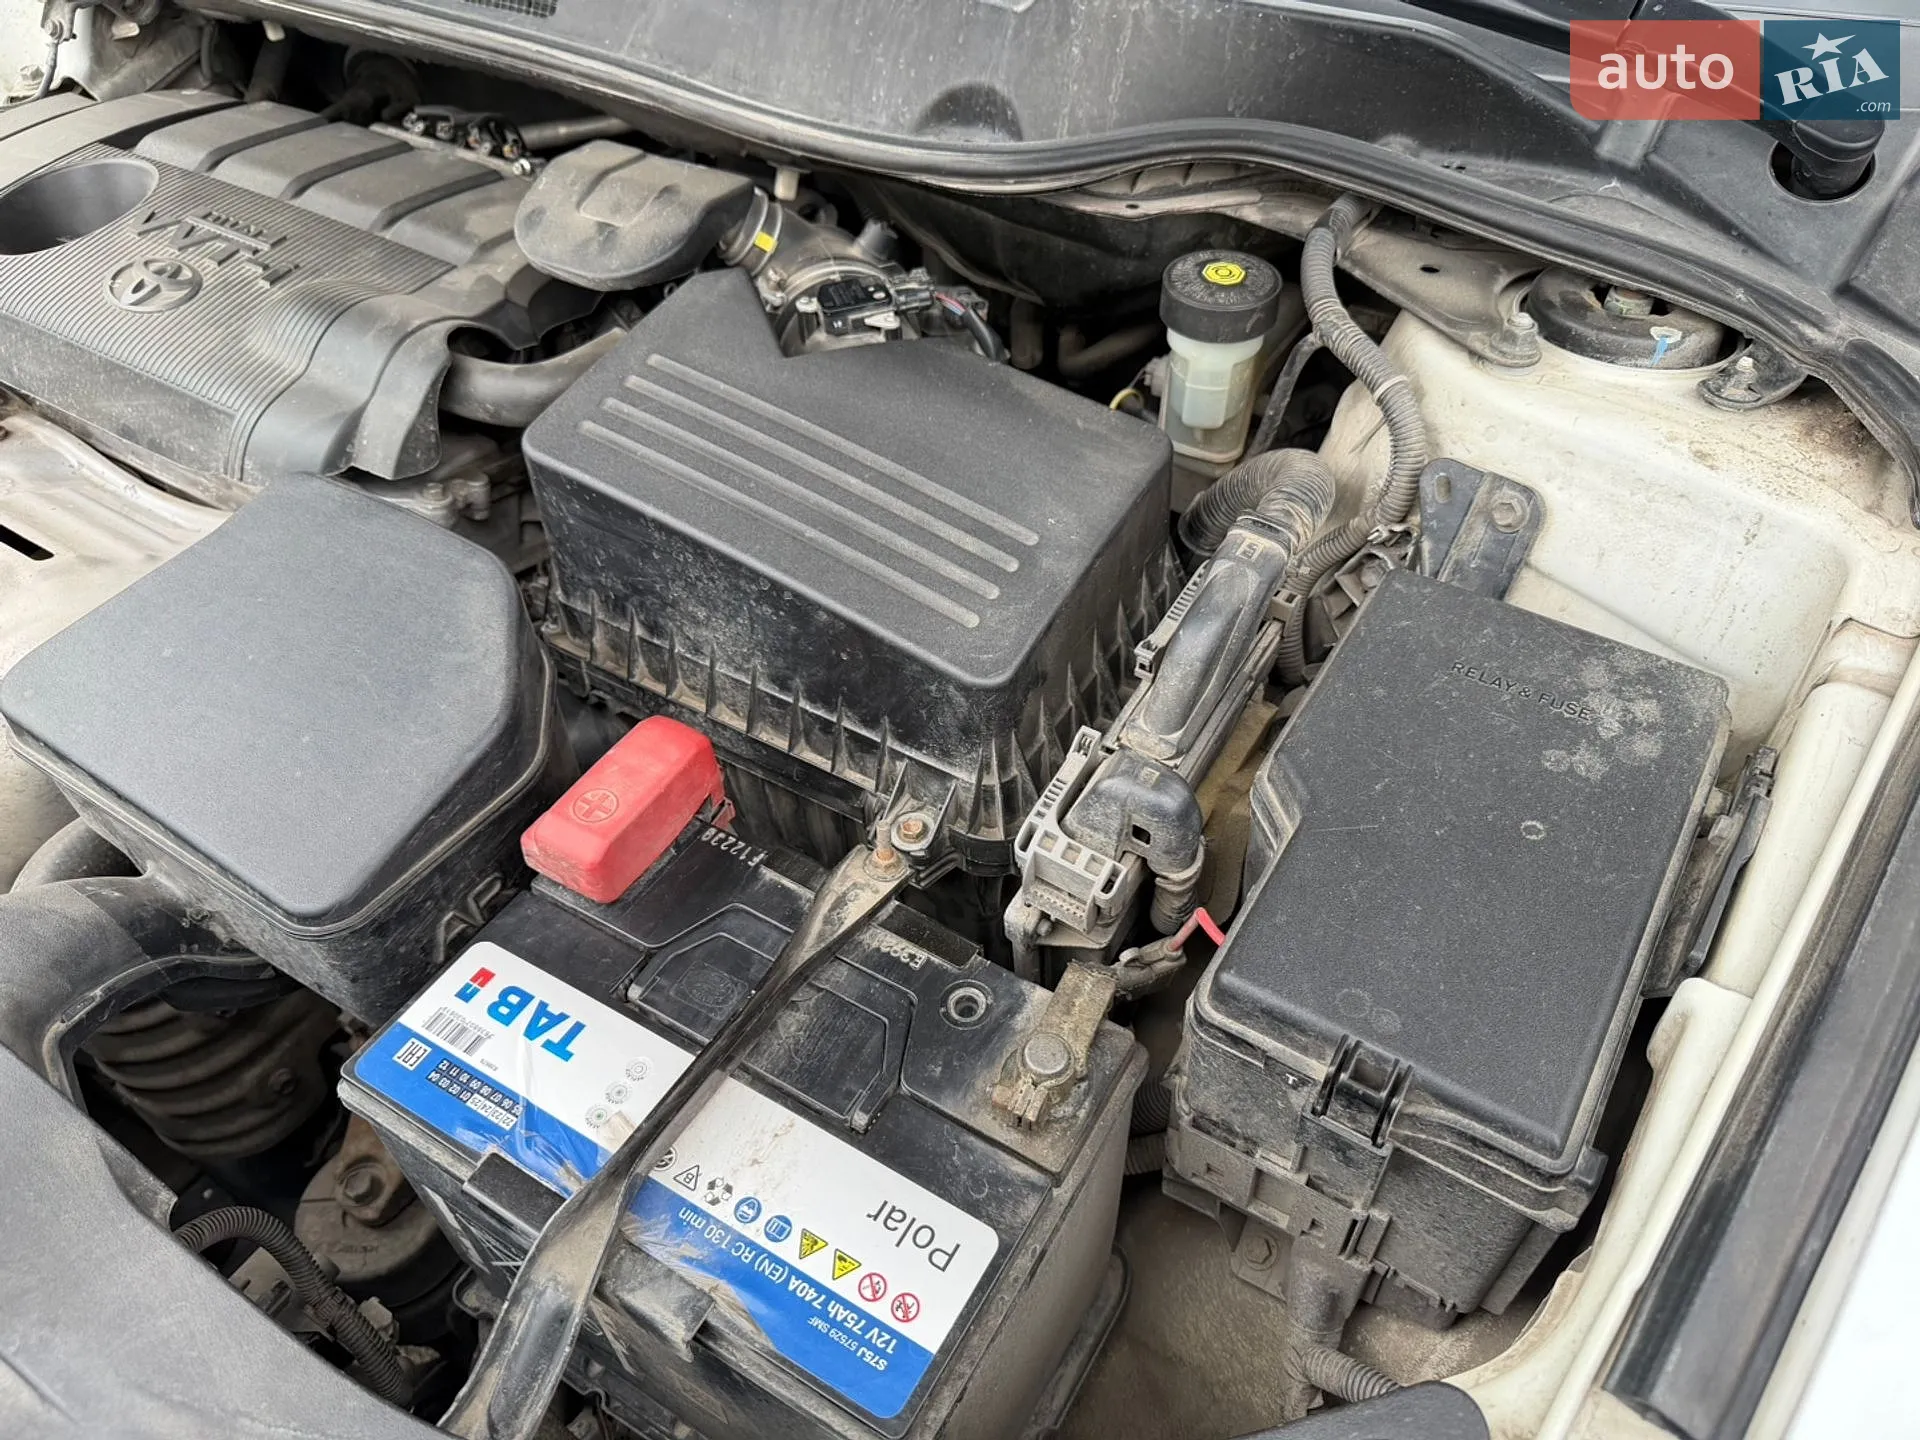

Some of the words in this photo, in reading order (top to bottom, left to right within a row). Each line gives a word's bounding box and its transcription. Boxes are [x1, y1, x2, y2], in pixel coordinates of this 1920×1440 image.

[1451, 661, 1517, 692] RELAY
[1518, 686, 1532, 698] &
[1538, 692, 1593, 721] FUSE
[486, 985, 586, 1062] TAB
[678, 1207, 706, 1229] min
[703, 1225, 731, 1249] 130
[866, 1200, 961, 1272] Polar
[731, 1240, 756, 1264] RC
[754, 1253, 789, 1284] (EN)
[788, 1275, 826, 1309] 740A
[807, 1316, 831, 1334] SMF
[827, 1300, 866, 1335] 75Ah
[864, 1326, 898, 1355] 12V
[856, 1346, 888, 1371] S75J
